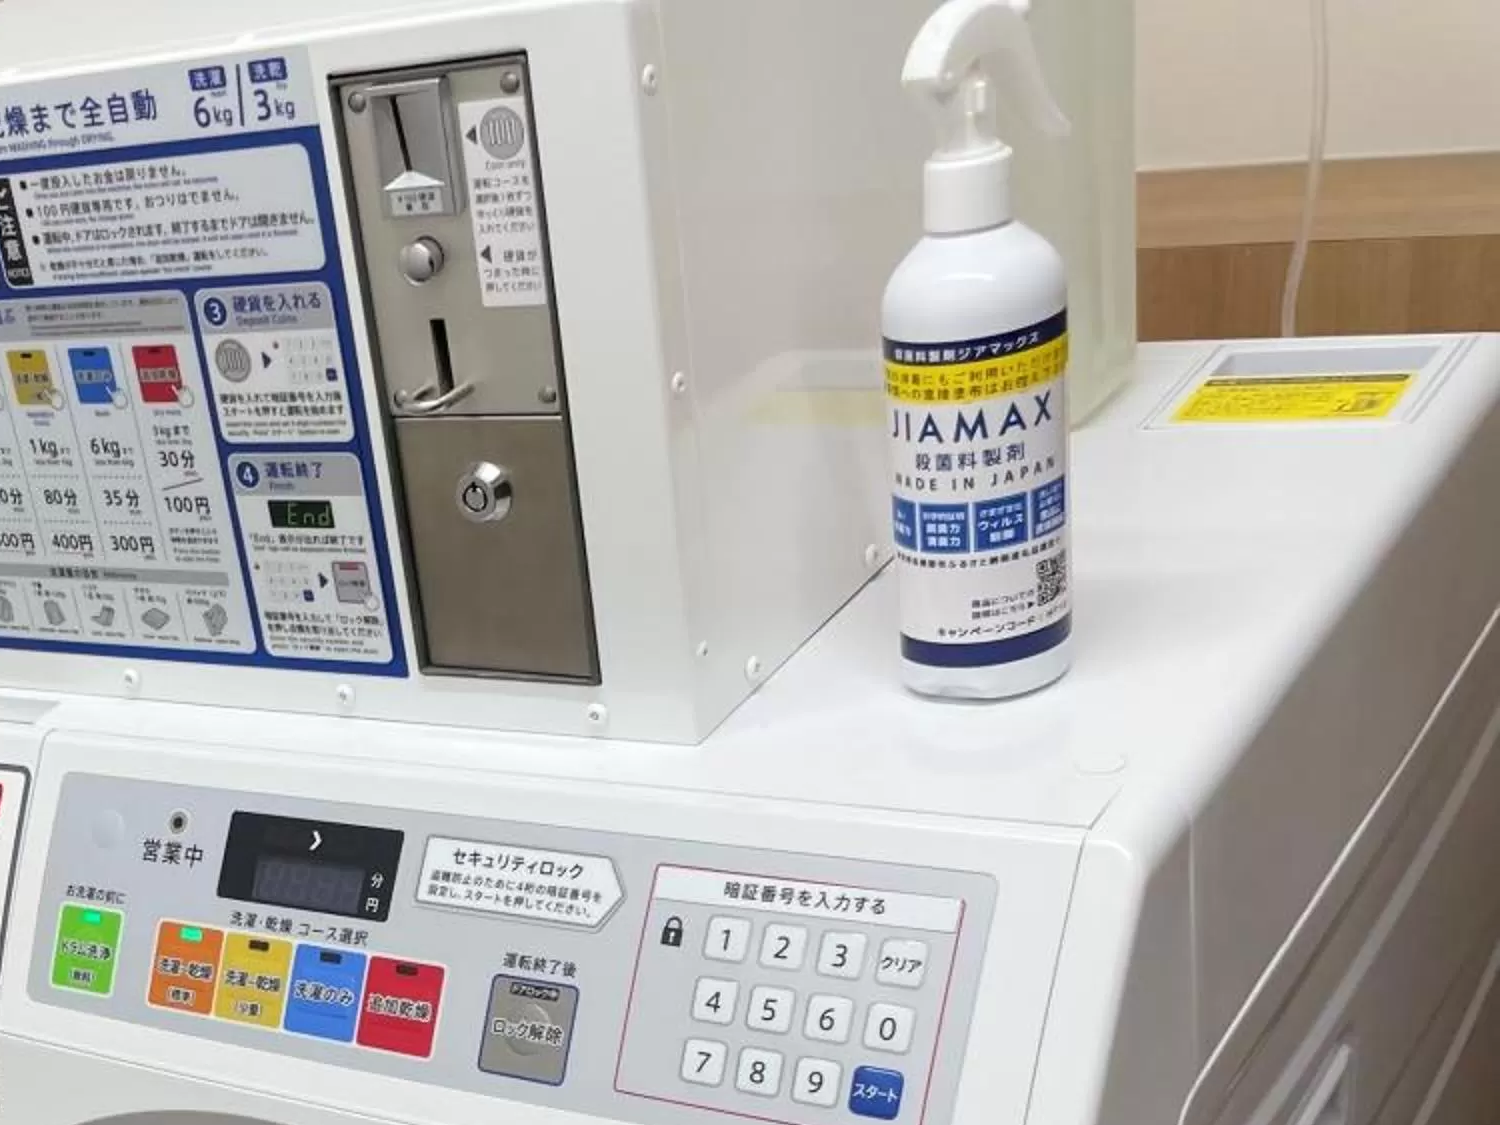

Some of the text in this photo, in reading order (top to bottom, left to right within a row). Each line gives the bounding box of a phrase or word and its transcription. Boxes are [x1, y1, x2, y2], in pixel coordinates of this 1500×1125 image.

[193, 95, 233, 128] 6kg
[253, 89, 296, 121] 3kg
[232, 292, 322, 313] 硬貨を入れる
[892, 390, 1051, 443] JIAMAX
[159, 450, 195, 470] 30分
[915, 441, 1025, 472] 殺菌料製剤
[951, 476, 975, 491] IN
[990, 457, 1055, 488] JAPAN
[44, 488, 78, 507] 80分
[103, 488, 140, 508] 35分
[164, 496, 211, 516] 100円
[287, 502, 332, 526] End
[52, 533, 94, 551] 400円
[111, 535, 155, 554] 300円
[142, 839, 204, 868] 営業中
[453, 848, 584, 880] セキュリティロック
[371, 871, 385, 890] 分
[65, 884, 127, 906] お洗濯の前に
[365, 896, 380, 914] 円
[723, 880, 886, 916] 暗証番号を入力する
[297, 922, 369, 947] コース選択
[721, 928, 731, 952] 1
[773, 935, 791, 961] 2
[831, 943, 849, 969] 3
[502, 951, 577, 979] 運転終了後
[880, 955, 923, 975] クリア
[293, 981, 354, 1007] 洗濯のみ
[705, 991, 722, 1014] 4
[367, 993, 432, 1021] 追加乾燥
[761, 998, 778, 1022] 5
[818, 1007, 836, 1032] 6
[878, 1017, 897, 1042] 0
[492, 1018, 564, 1046] ロック解除
[696, 1051, 712, 1073] 7
[749, 1060, 767, 1085] 8
[808, 1070, 824, 1094] 9
[852, 1082, 898, 1103] スタート
